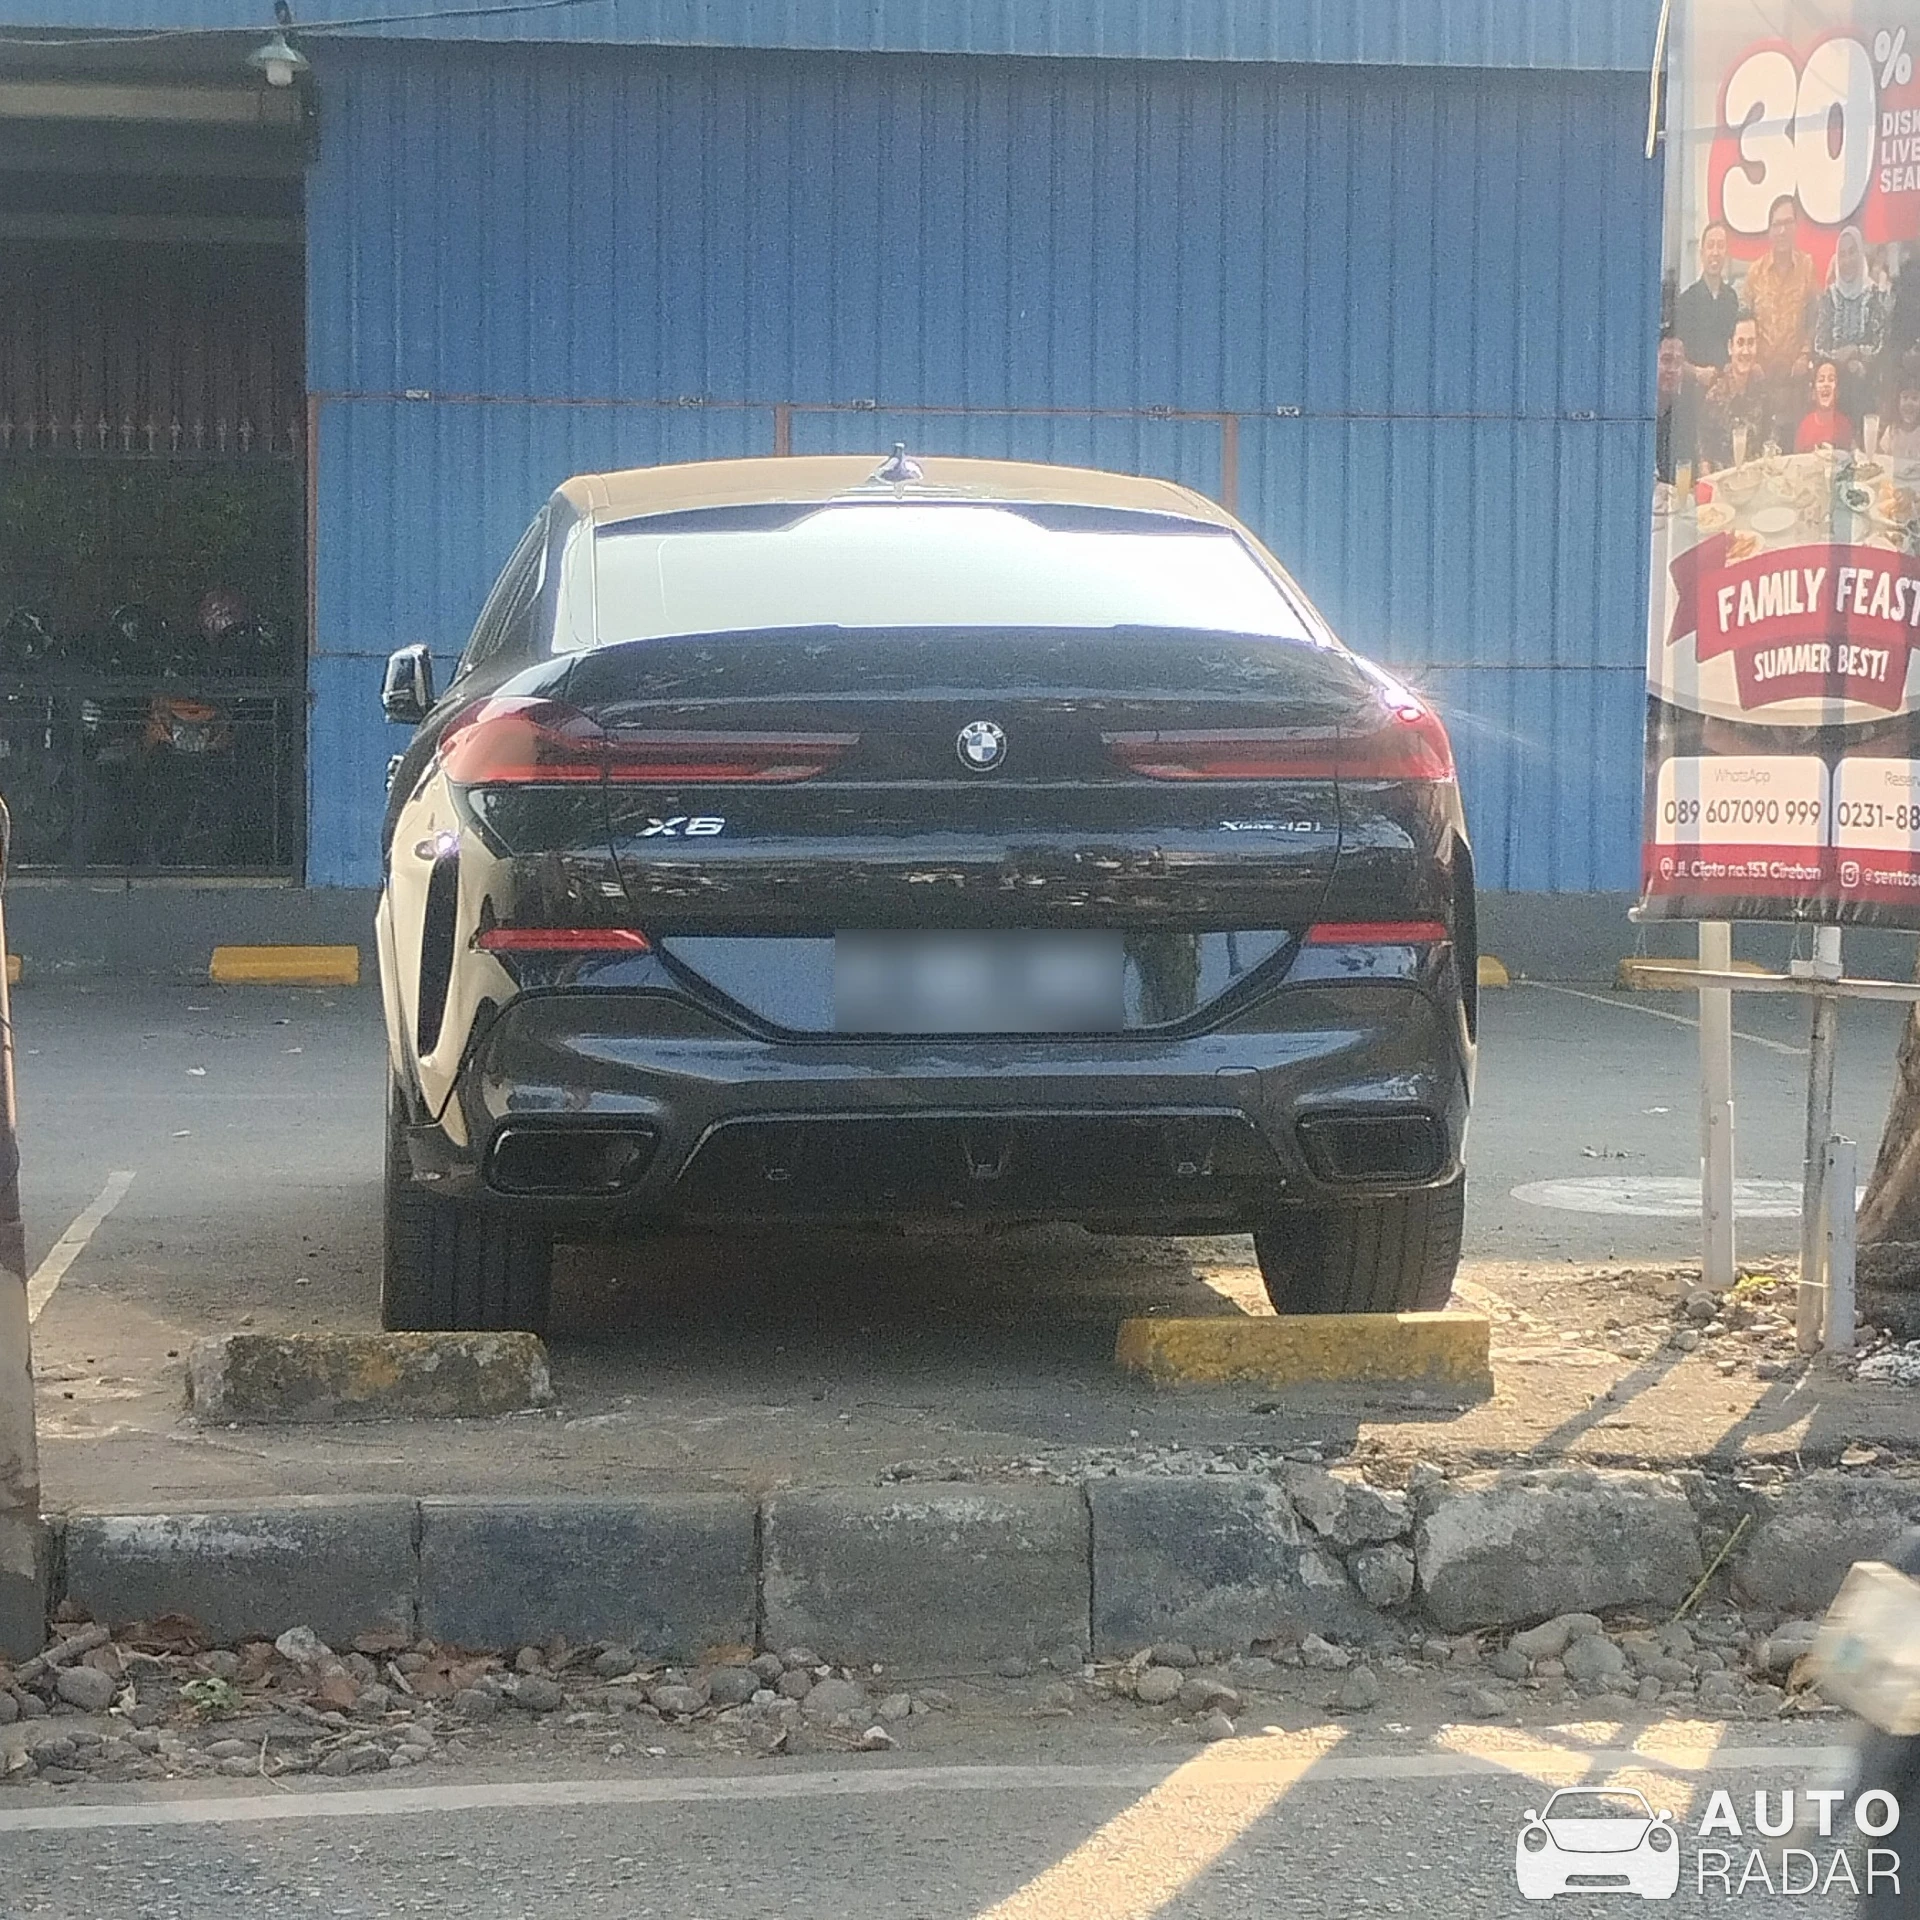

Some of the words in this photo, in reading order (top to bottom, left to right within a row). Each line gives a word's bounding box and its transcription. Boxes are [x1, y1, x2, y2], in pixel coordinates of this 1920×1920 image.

[1717, 567, 1826, 633] FAMILY
[1836, 566, 1920, 627] FEAST
[1754, 643, 1830, 682] SUMMER
[1837, 644, 1889, 682] BEST!
[1714, 768, 1771, 787] WhatsApp
[1664, 800, 1700, 825] 089
[1705, 800, 1779, 825] 607090
[1785, 801, 1821, 826] 999
[1837, 801, 1920, 831] 0231-88
[635, 816, 726, 838] X6
[1691, 860, 1726, 880] Cipto
